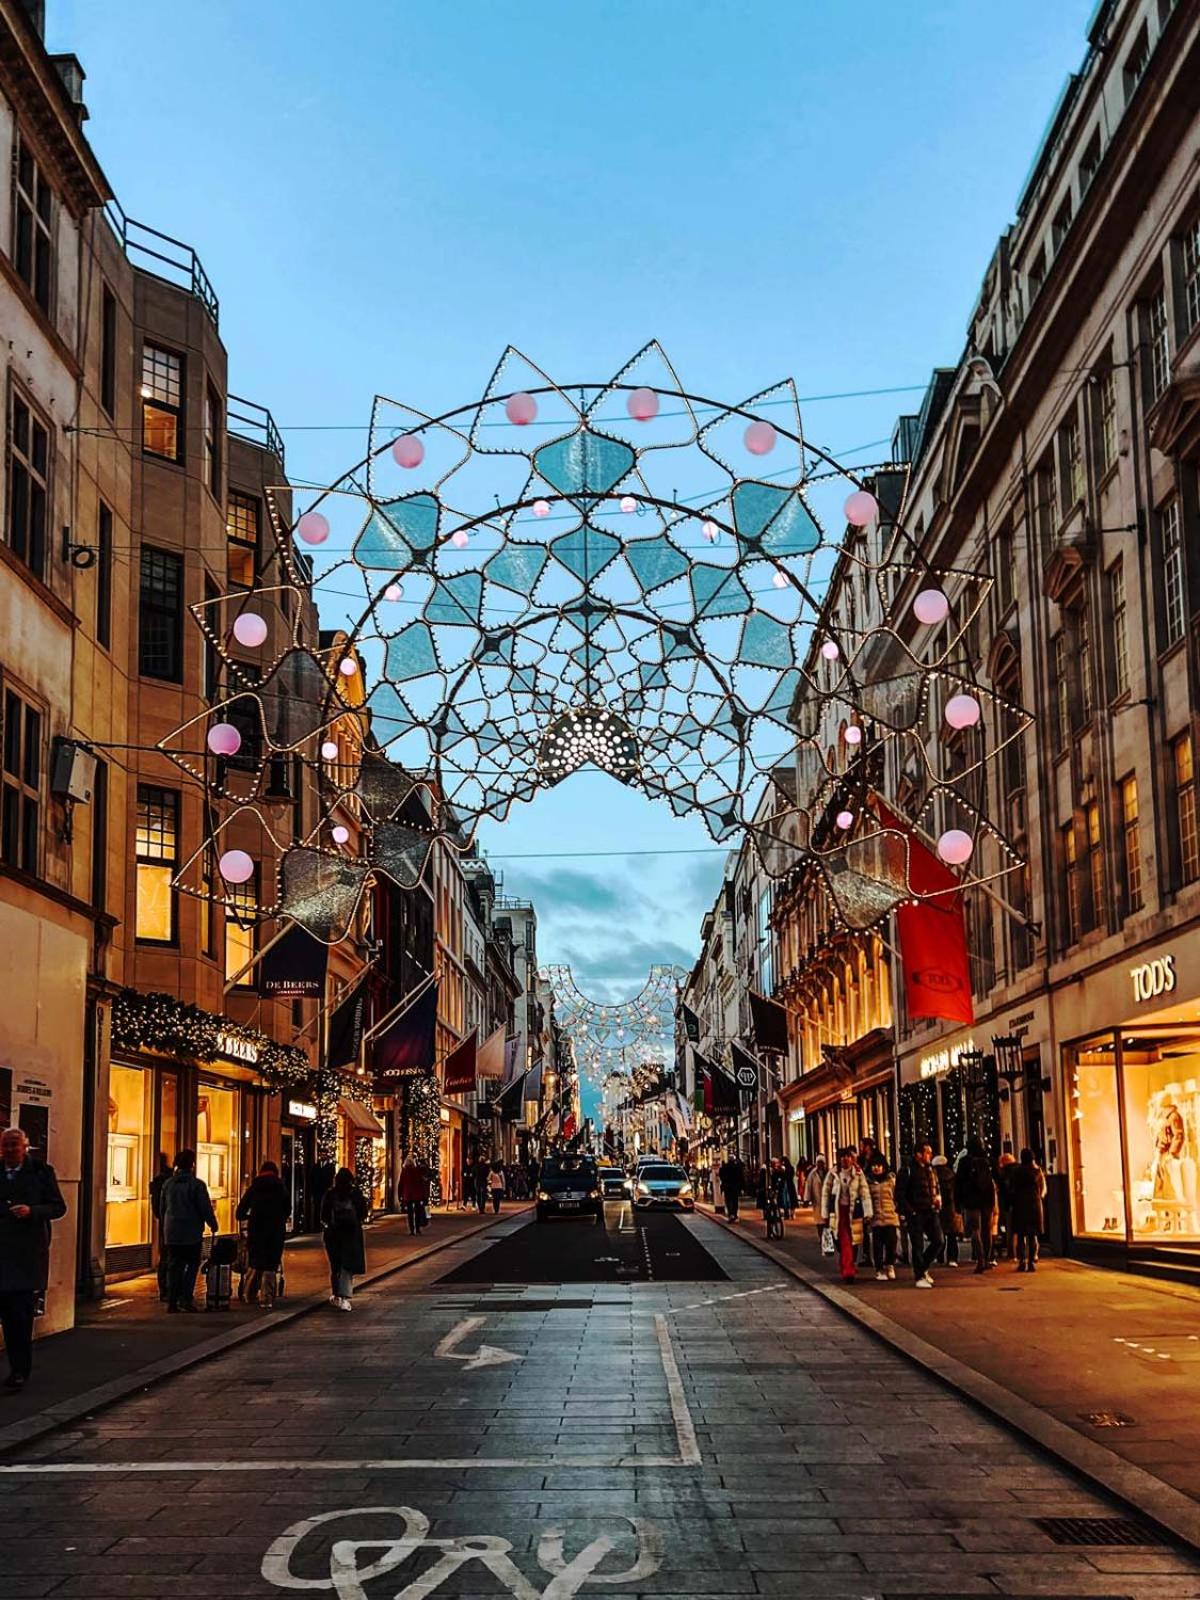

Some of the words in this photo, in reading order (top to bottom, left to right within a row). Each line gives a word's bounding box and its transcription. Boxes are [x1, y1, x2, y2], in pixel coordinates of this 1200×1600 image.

[265, 980, 281, 989] DE
[283, 980, 319, 989] BEERS
[1130, 955, 1174, 1002] TOD'S
